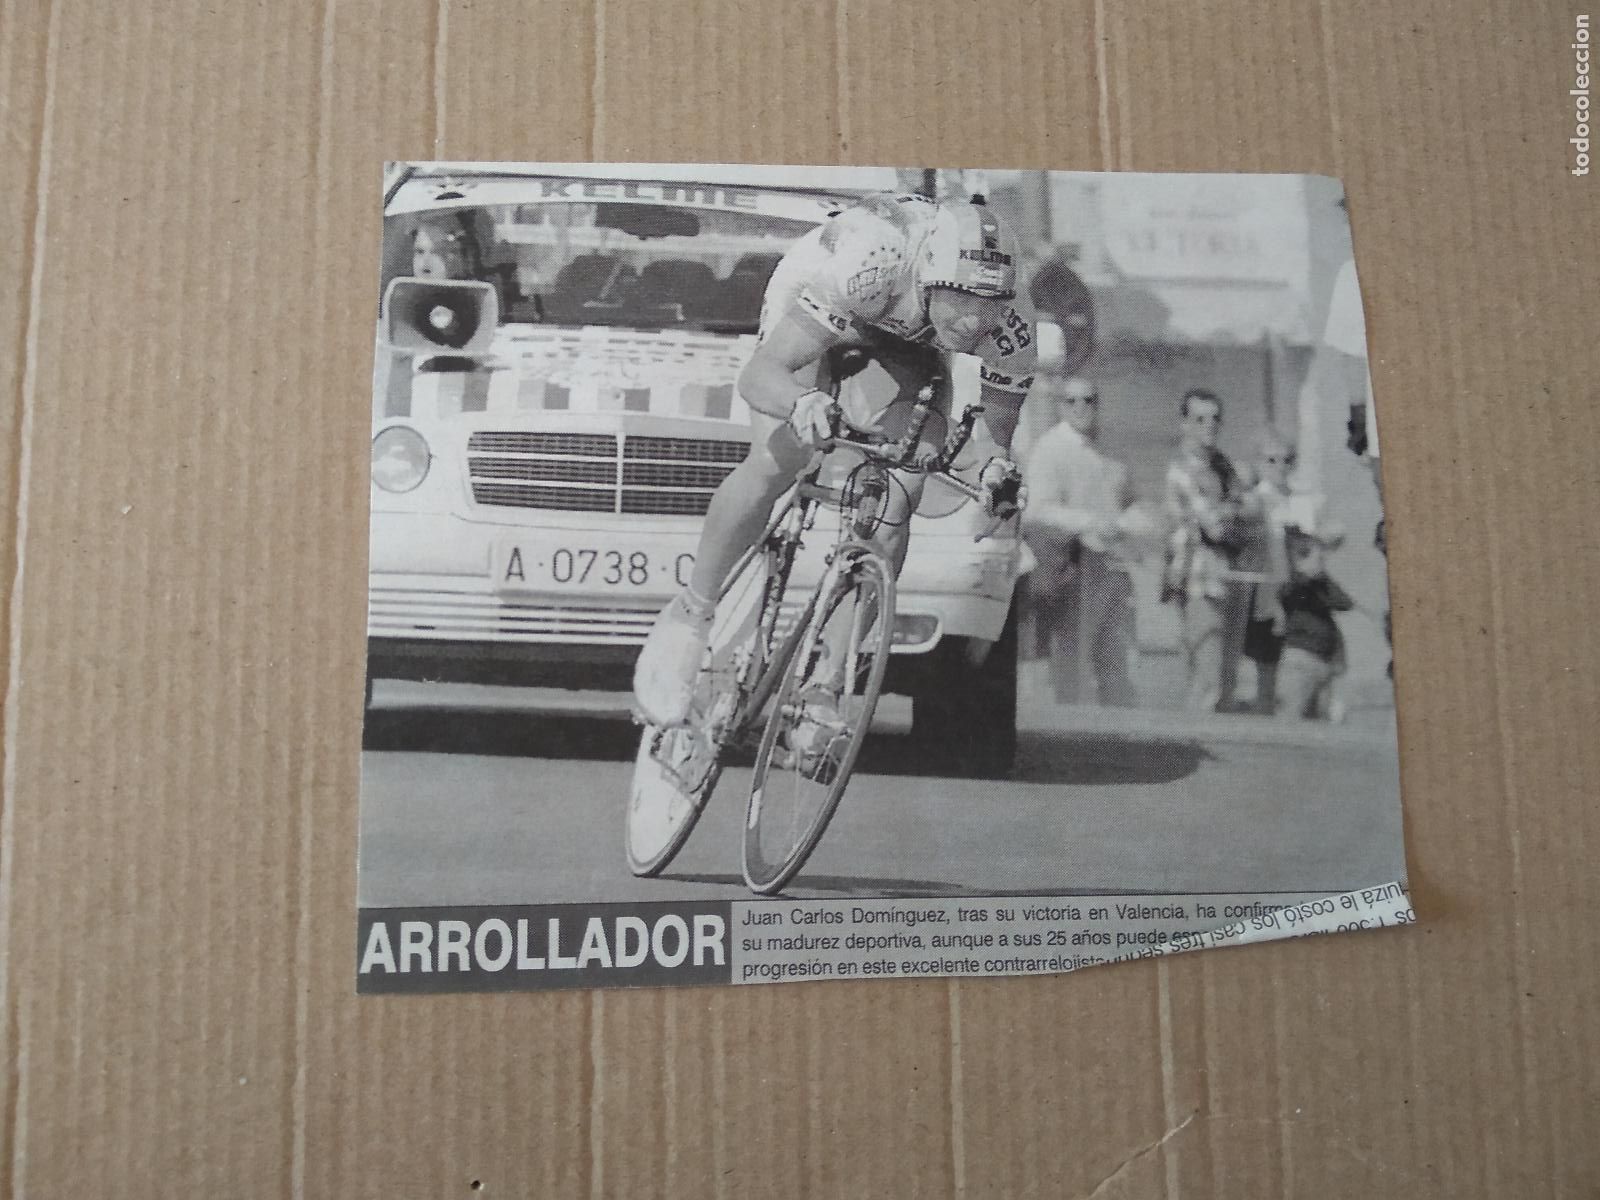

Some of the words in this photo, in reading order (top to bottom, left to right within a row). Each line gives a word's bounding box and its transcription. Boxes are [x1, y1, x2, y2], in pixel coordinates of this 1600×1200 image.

[1284, 899, 1335, 928] costó
[1340, 894, 1360, 911] le
[742, 909, 783, 926] Juan
[790, 908, 844, 925] Carlos
[851, 906, 950, 927] Domínguez,
[958, 907, 989, 923] tras
[996, 909, 1016, 922] su
[1023, 905, 1082, 921] victoria
[1088, 907, 1109, 920] en
[1115, 903, 1189, 921] Valencia,
[1196, 903, 1217, 919] ha
[1251, 914, 1281, 930] los
[359, 913, 726, 974] ARROLLADOR
[742, 937, 762, 951] su
[767, 934, 840, 951] madurez
[845, 931, 926, 952] deportiva,
[931, 933, 994, 951] aunque
[998, 934, 1009, 947] a
[1013, 932, 1042, 947] sus
[1046, 930, 1066, 947] 25
[1071, 929, 1112, 946] años
[1116, 929, 1168, 948] puede
[1210, 921, 1246, 947] casi
[742, 957, 833, 980] progresión
[837, 960, 858, 975] en
[863, 960, 897, 974] este
[901, 956, 980, 974] excelente
